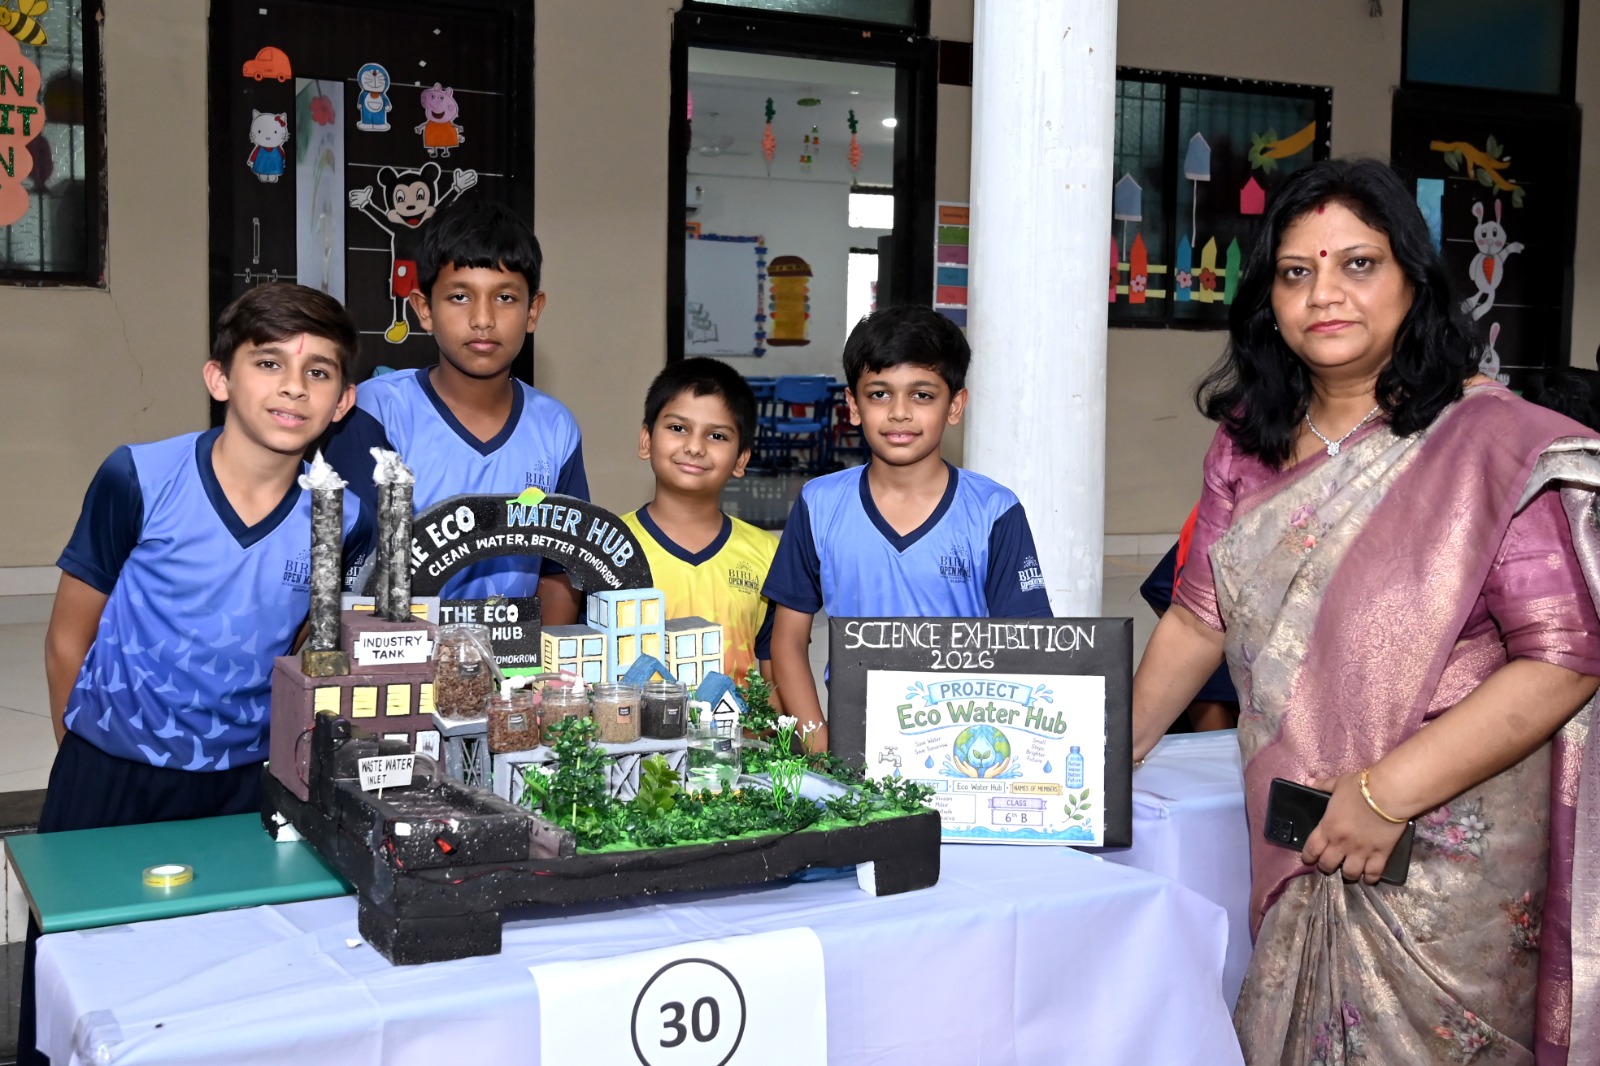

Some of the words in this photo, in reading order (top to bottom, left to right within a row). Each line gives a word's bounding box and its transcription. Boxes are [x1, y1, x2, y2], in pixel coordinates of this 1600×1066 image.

[411, 537, 430, 575] HE
[425, 505, 476, 549] ECO
[507, 503, 582, 536] WATER
[586, 517, 635, 568] HUB
[284, 559, 309, 575] BIR
[428, 542, 471, 577] CLEAN
[476, 533, 529, 550] WATER,
[530, 534, 575, 556] BETTER
[578, 547, 622, 589] TOMORROW
[728, 568, 759, 583] BIRLA
[440, 606, 478, 623] THE
[484, 604, 519, 623] ECO
[492, 627, 523, 641] HUB
[844, 621, 942, 649] SCIENCE
[951, 622, 1096, 652] EXHIBITION
[363, 635, 423, 649] INDUSTRY
[372, 650, 405, 660] TANK
[930, 650, 995, 669] 2026
[940, 681, 1019, 699] PROJECT
[897, 703, 942, 730] Eco
[946, 700, 1020, 724] Water
[1024, 706, 1067, 735] Hub
[361, 760, 382, 773] WASTE
[385, 758, 413, 771] WATER
[368, 774, 387, 785] INLET
[971, 783, 989, 791] Water
[1006, 799, 1027, 807] CLASS
[1005, 813, 1018, 823] 6th
[1021, 814, 1028, 823] B
[660, 996, 720, 1048] 30
